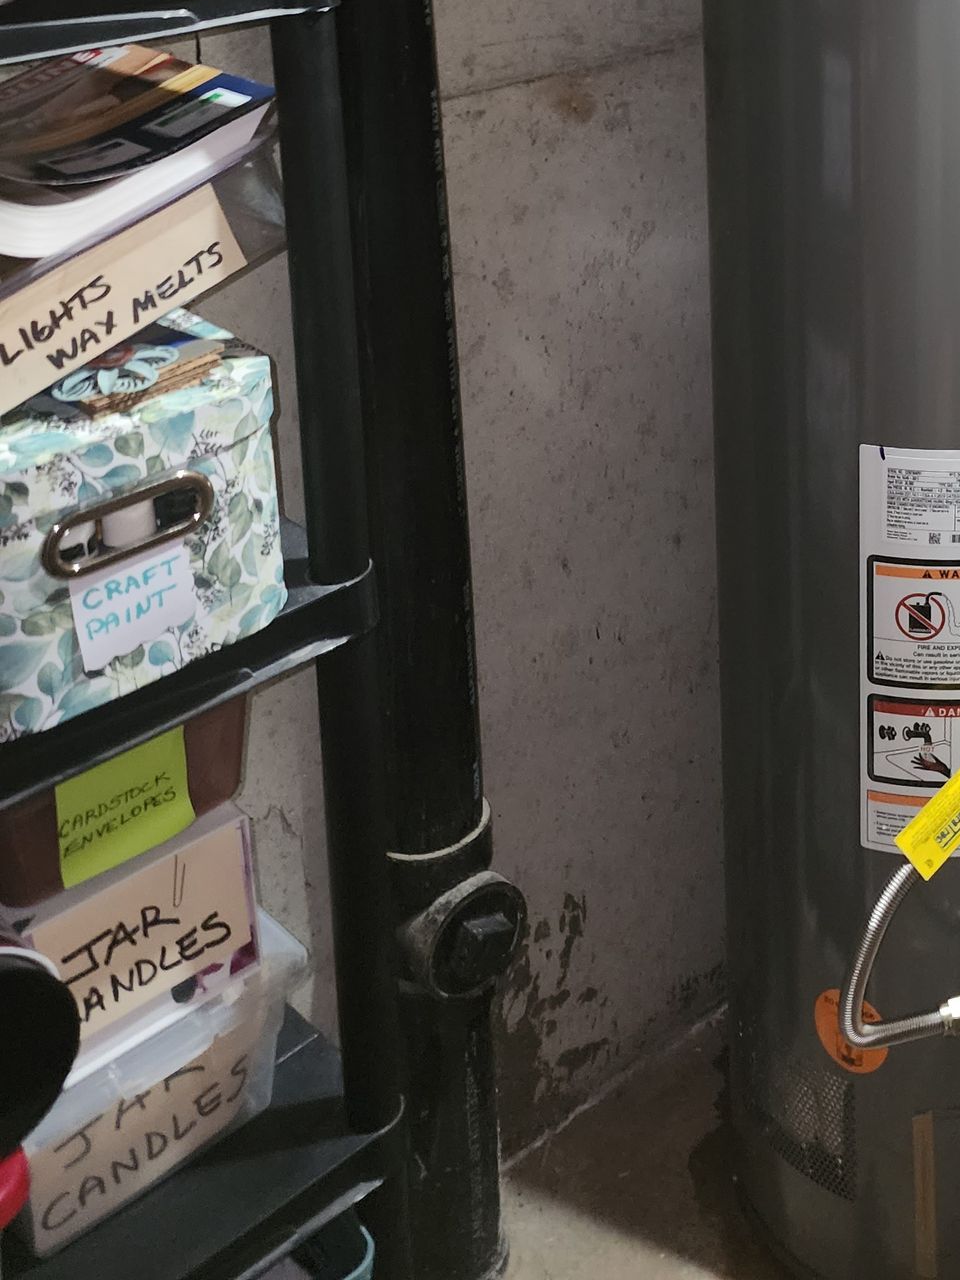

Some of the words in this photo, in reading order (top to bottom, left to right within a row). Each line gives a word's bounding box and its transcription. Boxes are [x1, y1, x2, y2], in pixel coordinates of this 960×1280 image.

[0, 274, 112, 366] LIGHTS
[46, 311, 117, 370] WAX
[132, 240, 224, 324] MELTS
[82, 554, 181, 610] CRAFT
[85, 583, 177, 640] PAINT
[58, 771, 171, 839] CARDSTOCK
[63, 786, 178, 859] ENVELOPES
[61, 904, 180, 985] JAR
[79, 910, 232, 1023] ANDLES
[41, 1053, 249, 1232] CANDLES
